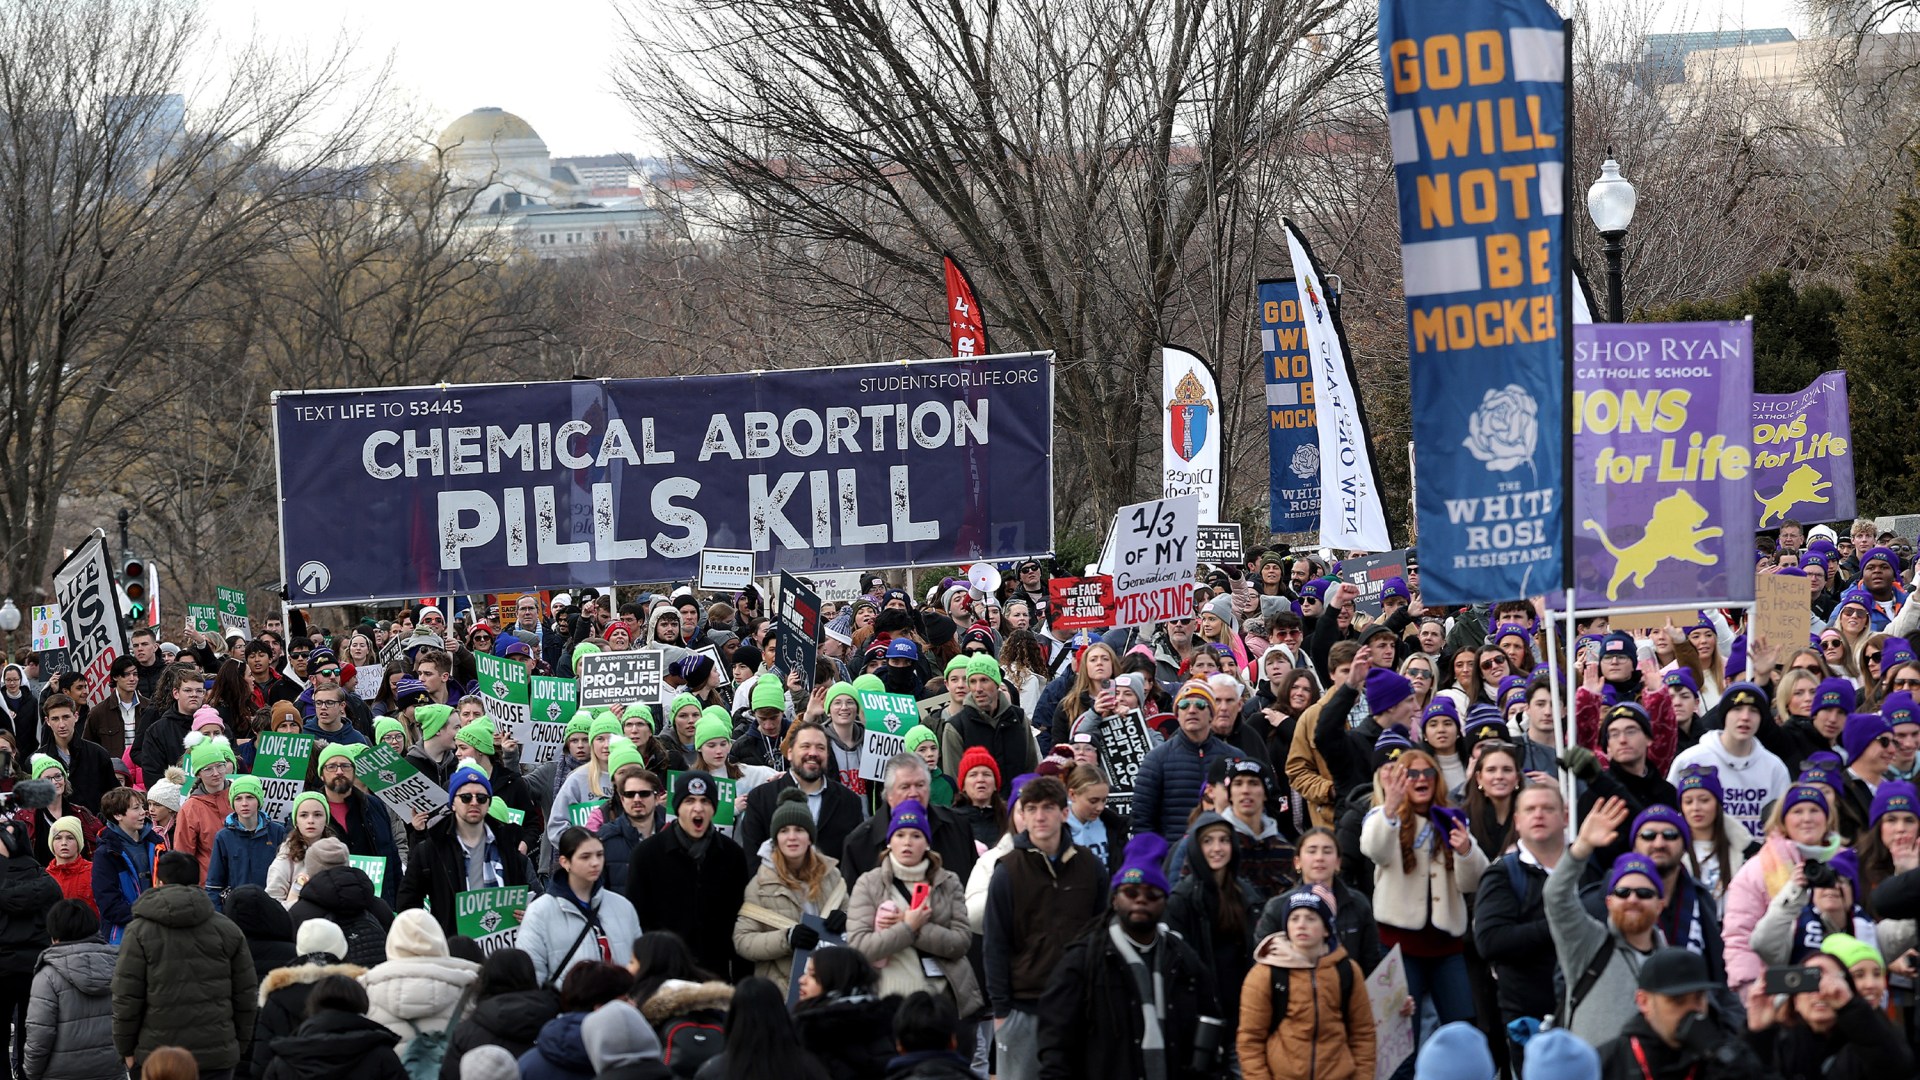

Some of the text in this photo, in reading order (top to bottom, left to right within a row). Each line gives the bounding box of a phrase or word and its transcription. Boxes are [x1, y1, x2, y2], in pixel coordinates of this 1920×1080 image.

[1389, 29, 1505, 95] GOD
[1418, 94, 1556, 161] WILL
[1416, 163, 1537, 230] NOT
[1484, 229, 1551, 290] BE
[1412, 294, 1556, 353] MOCKE
[1574, 337, 1741, 363] SHOP RYAN
[1576, 366, 1713, 380] CATHOLIC SCHOOL
[1752, 380, 1836, 412] SHOP RYAN
[294, 399, 463, 422] TEXT LIFE TO 53445
[362, 398, 989, 480] CHEMICAL ABORTION
[1754, 432, 1848, 469] for Life
[1595, 431, 1751, 485] for Life
[1497, 481, 1521, 492] THE
[437, 477, 708, 570] PILLS
[749, 465, 940, 551] KILL
[1444, 488, 1554, 524] WHITE
[1131, 501, 1175, 539] 1/3
[1196, 540, 1240, 550] O-LIFE
[1197, 531, 1235, 540] M THE
[1466, 518, 1546, 551] ROSE
[1125, 536, 1188, 565] OF MY
[705, 564, 750, 573] FREEDOM
[1117, 567, 1177, 590] Generation
[58, 556, 99, 614] LIFE
[217, 587, 245, 605] LOVE LIFE
[1060, 583, 1103, 596] IN THE FACE
[189, 606, 216, 619] LOVE LIFE
[1062, 605, 1105, 618] WE STAND
[1067, 597, 1076, 605] OF
[1114, 583, 1193, 625] MISSING
[61, 584, 104, 649] IS
[222, 613, 246, 629] CHOOSE
[477, 655, 525, 684] LOVE LIFE
[583, 670, 660, 688] PRO-LIFE
[587, 660, 656, 674] I AM THE
[533, 680, 575, 702] LOVE LIFE
[584, 685, 658, 699] GENERATION
[861, 692, 891, 712] LOVE
[891, 696, 917, 716] LIFE
[485, 696, 524, 723] CHOOSE
[259, 735, 311, 758] LOVE LIFE
[369, 746, 399, 768] LIFE
[383, 776, 430, 804] CHOOSE
[1723, 802, 1759, 816] RYAN
[459, 889, 525, 917] LOVE LIFE
